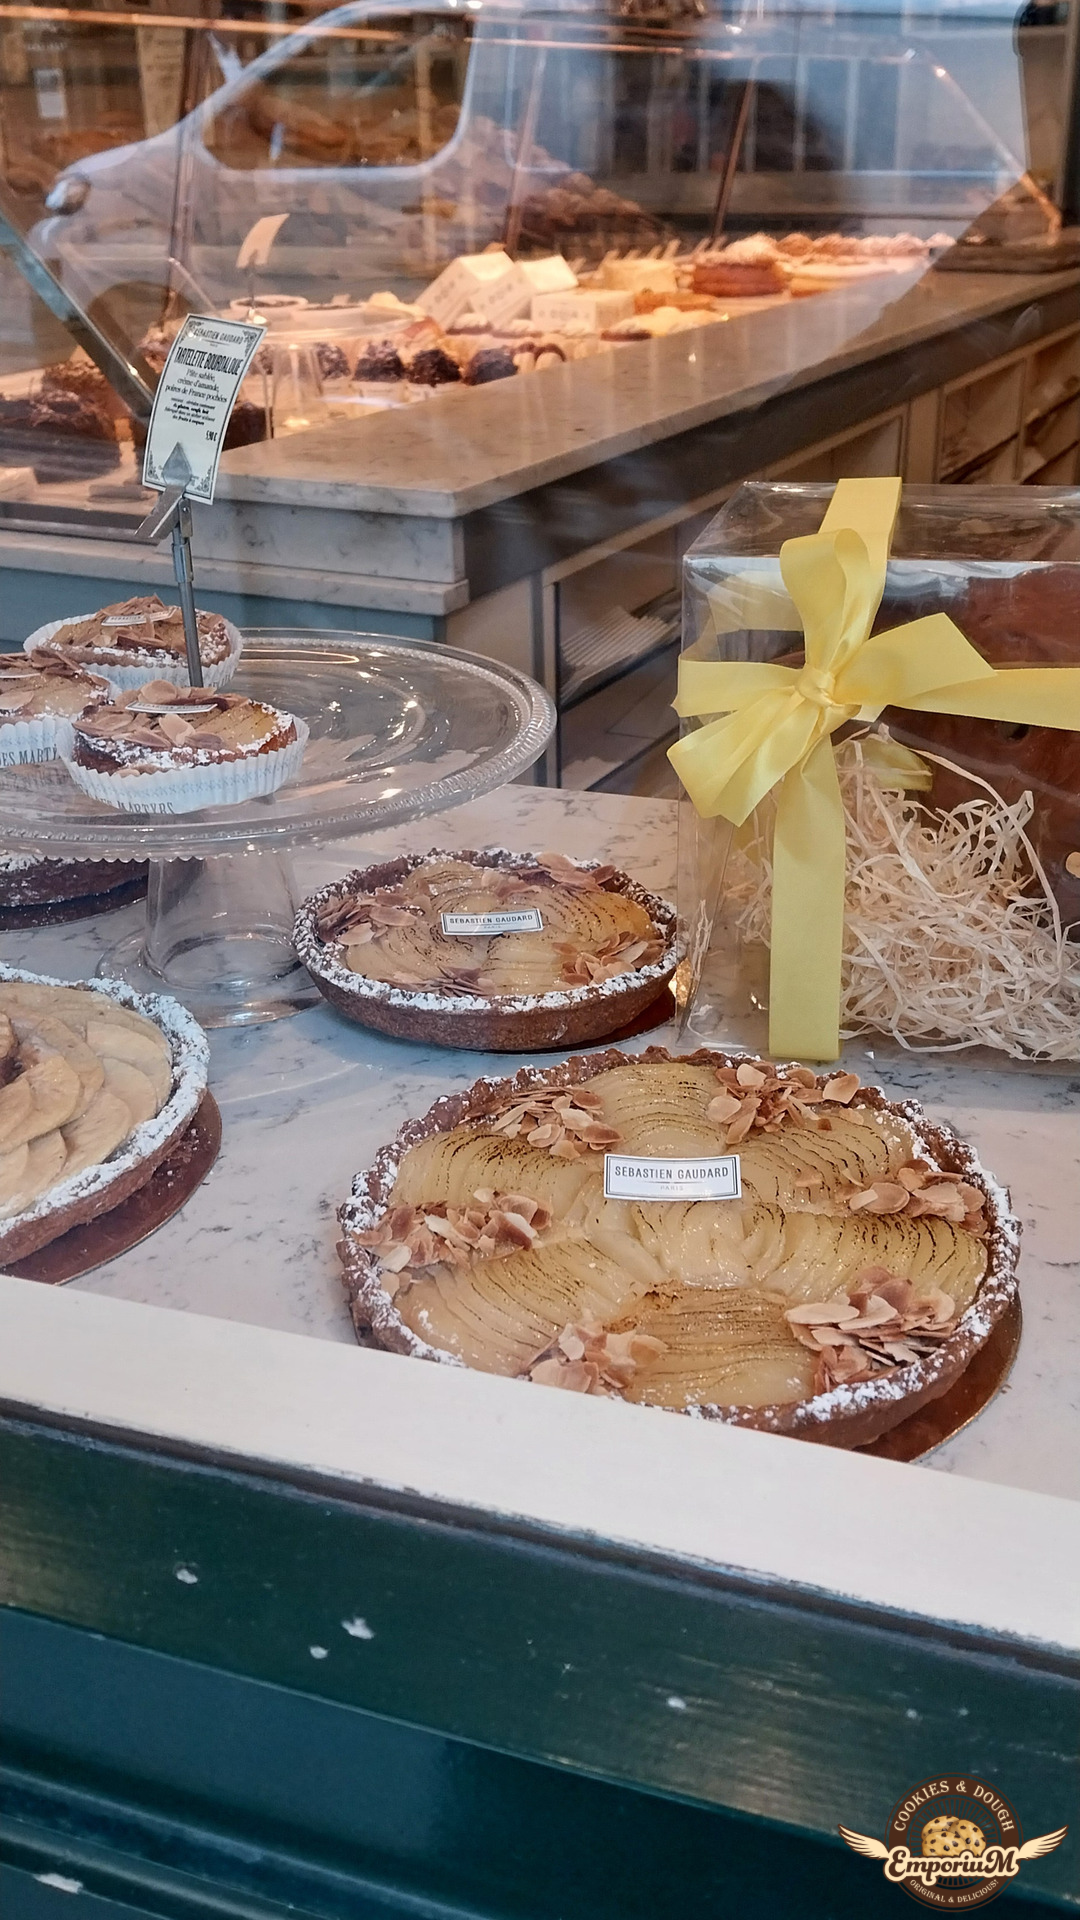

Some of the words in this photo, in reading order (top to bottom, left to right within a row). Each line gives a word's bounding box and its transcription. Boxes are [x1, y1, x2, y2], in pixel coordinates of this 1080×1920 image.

[174, 346, 208, 368] TARTELETTE
[203, 353, 244, 375] BOURDALOUE
[177, 377, 193, 386] crème
[165, 384, 181, 393] poires
[188, 388, 206, 398] France
[206, 393, 227, 403] pochées
[0, 752, 16, 767] ES
[495, 914, 534, 923] GAUDARD
[677, 1167, 729, 1179] GAUDARD
